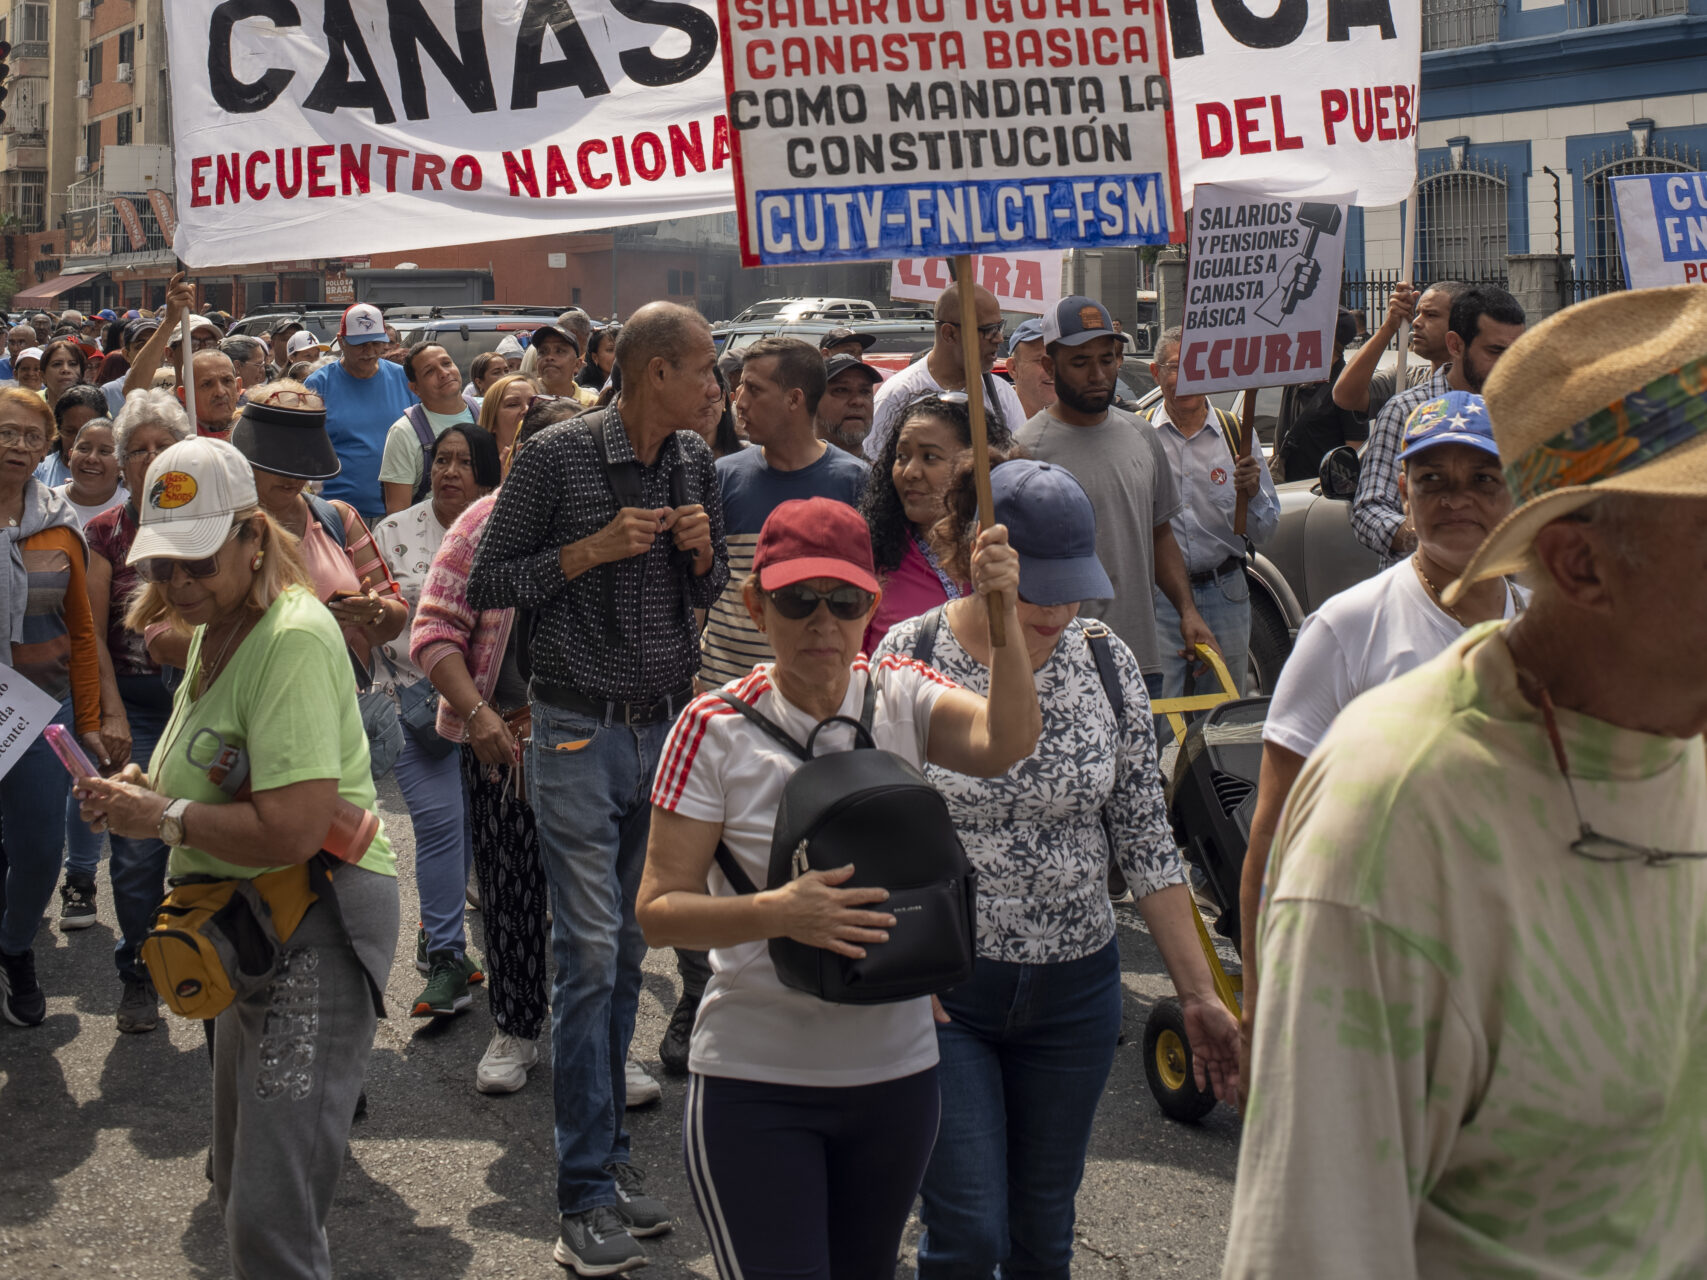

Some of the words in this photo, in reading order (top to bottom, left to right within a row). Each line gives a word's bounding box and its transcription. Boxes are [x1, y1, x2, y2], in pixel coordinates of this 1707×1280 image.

[746, 30, 967, 80] CANASTA
[983, 26, 1149, 69] BASICA
[730, 83, 867, 131] COMO
[886, 76, 1106, 122] MANDATA
[1120, 73, 1171, 113] LA
[190, 143, 483, 208] ENCUENTRO
[502, 115, 732, 198] NACIONA
[1196, 95, 1304, 159] DEL
[1321, 84, 1416, 145] PUEB
[787, 116, 1132, 178] CONSTITUCIÓN
[1199, 202, 1293, 231] SALARIOS
[1198, 237, 1208, 255] Y
[1209, 229, 1300, 255] PENSIONES
[1193, 255, 1264, 280] IGUALES
[1265, 254, 1277, 273] A
[326, 285, 354, 294] BRASA
[1190, 280, 1264, 305] CANASTA
[1186, 306, 1246, 330] BÁSICA
[1183, 330, 1322, 382] CCURA
[164, 472, 188, 483] Bass
[165, 483, 182, 493] Pro
[0, 716, 30, 756] cente!
